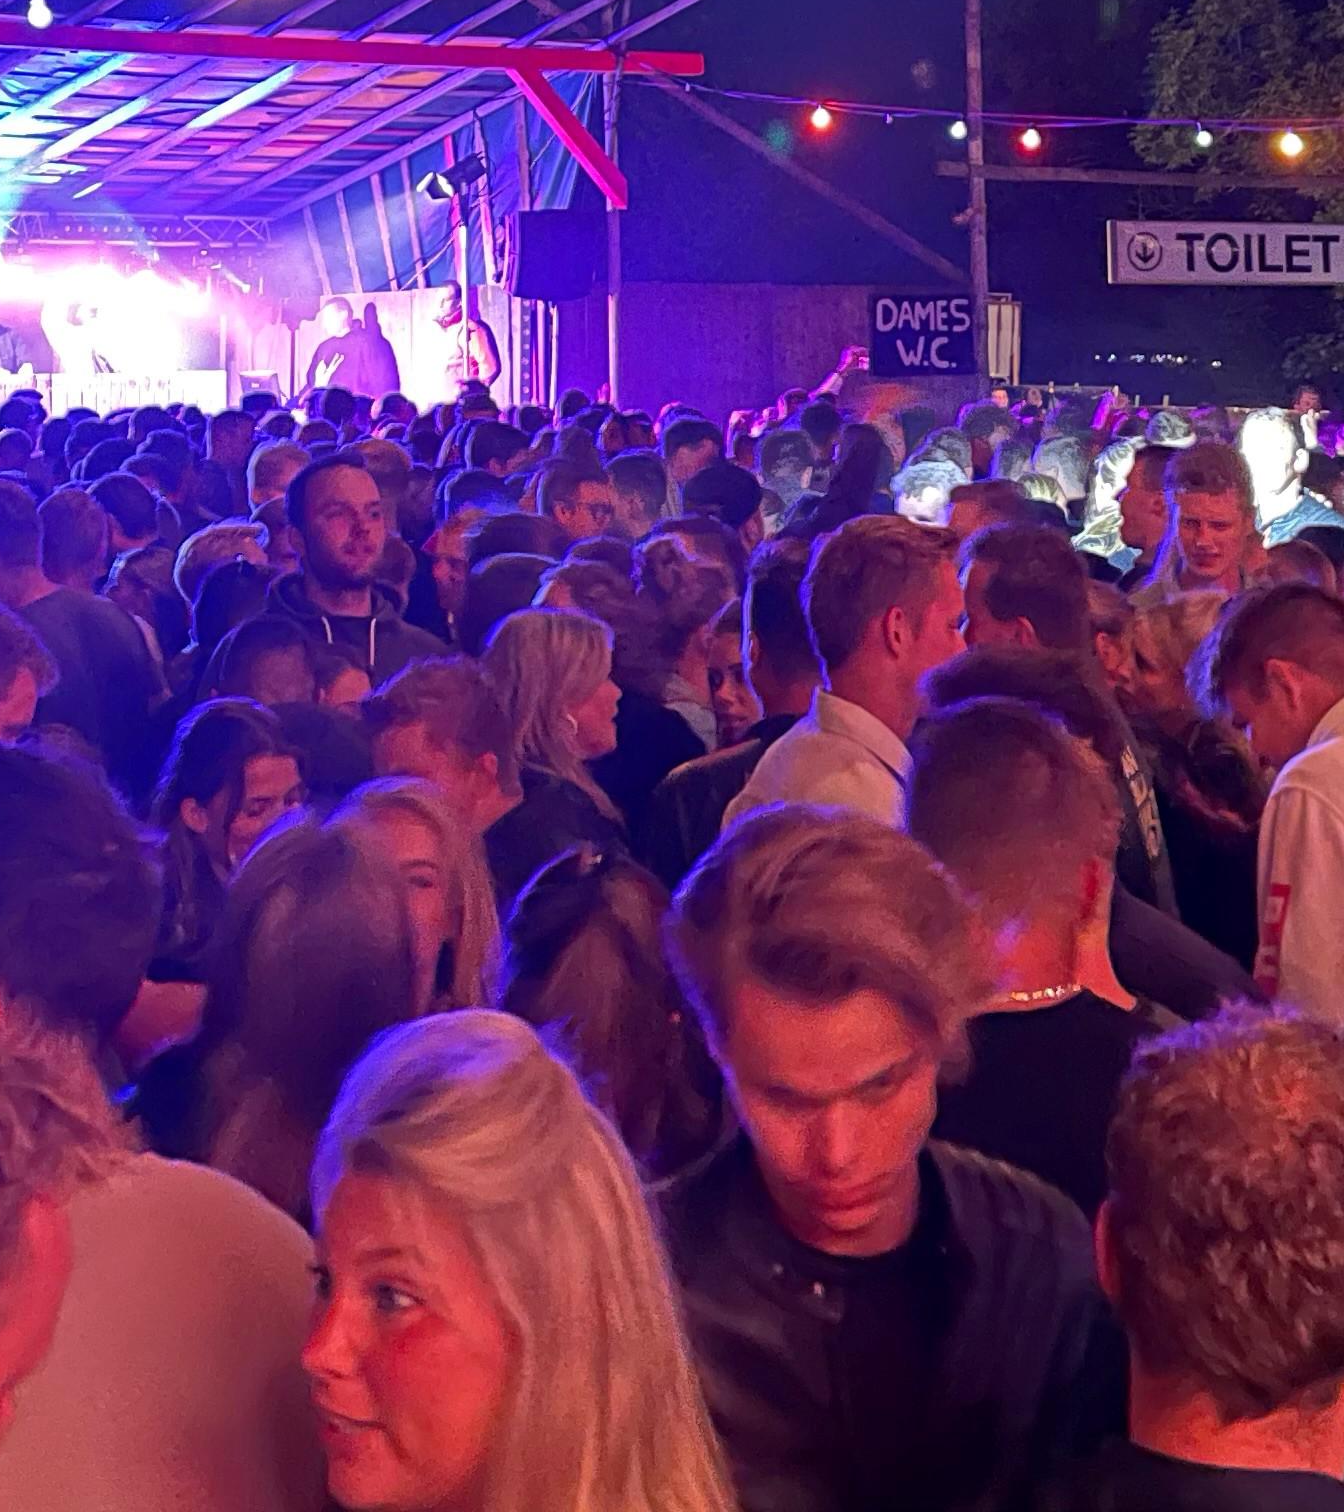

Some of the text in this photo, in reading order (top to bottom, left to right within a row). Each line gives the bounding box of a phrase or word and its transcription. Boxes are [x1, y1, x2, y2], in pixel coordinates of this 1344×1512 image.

[1175, 232, 1341, 273] TOILET
[876, 298, 970, 332] DAMES
[896, 336, 957, 368] W.C.
